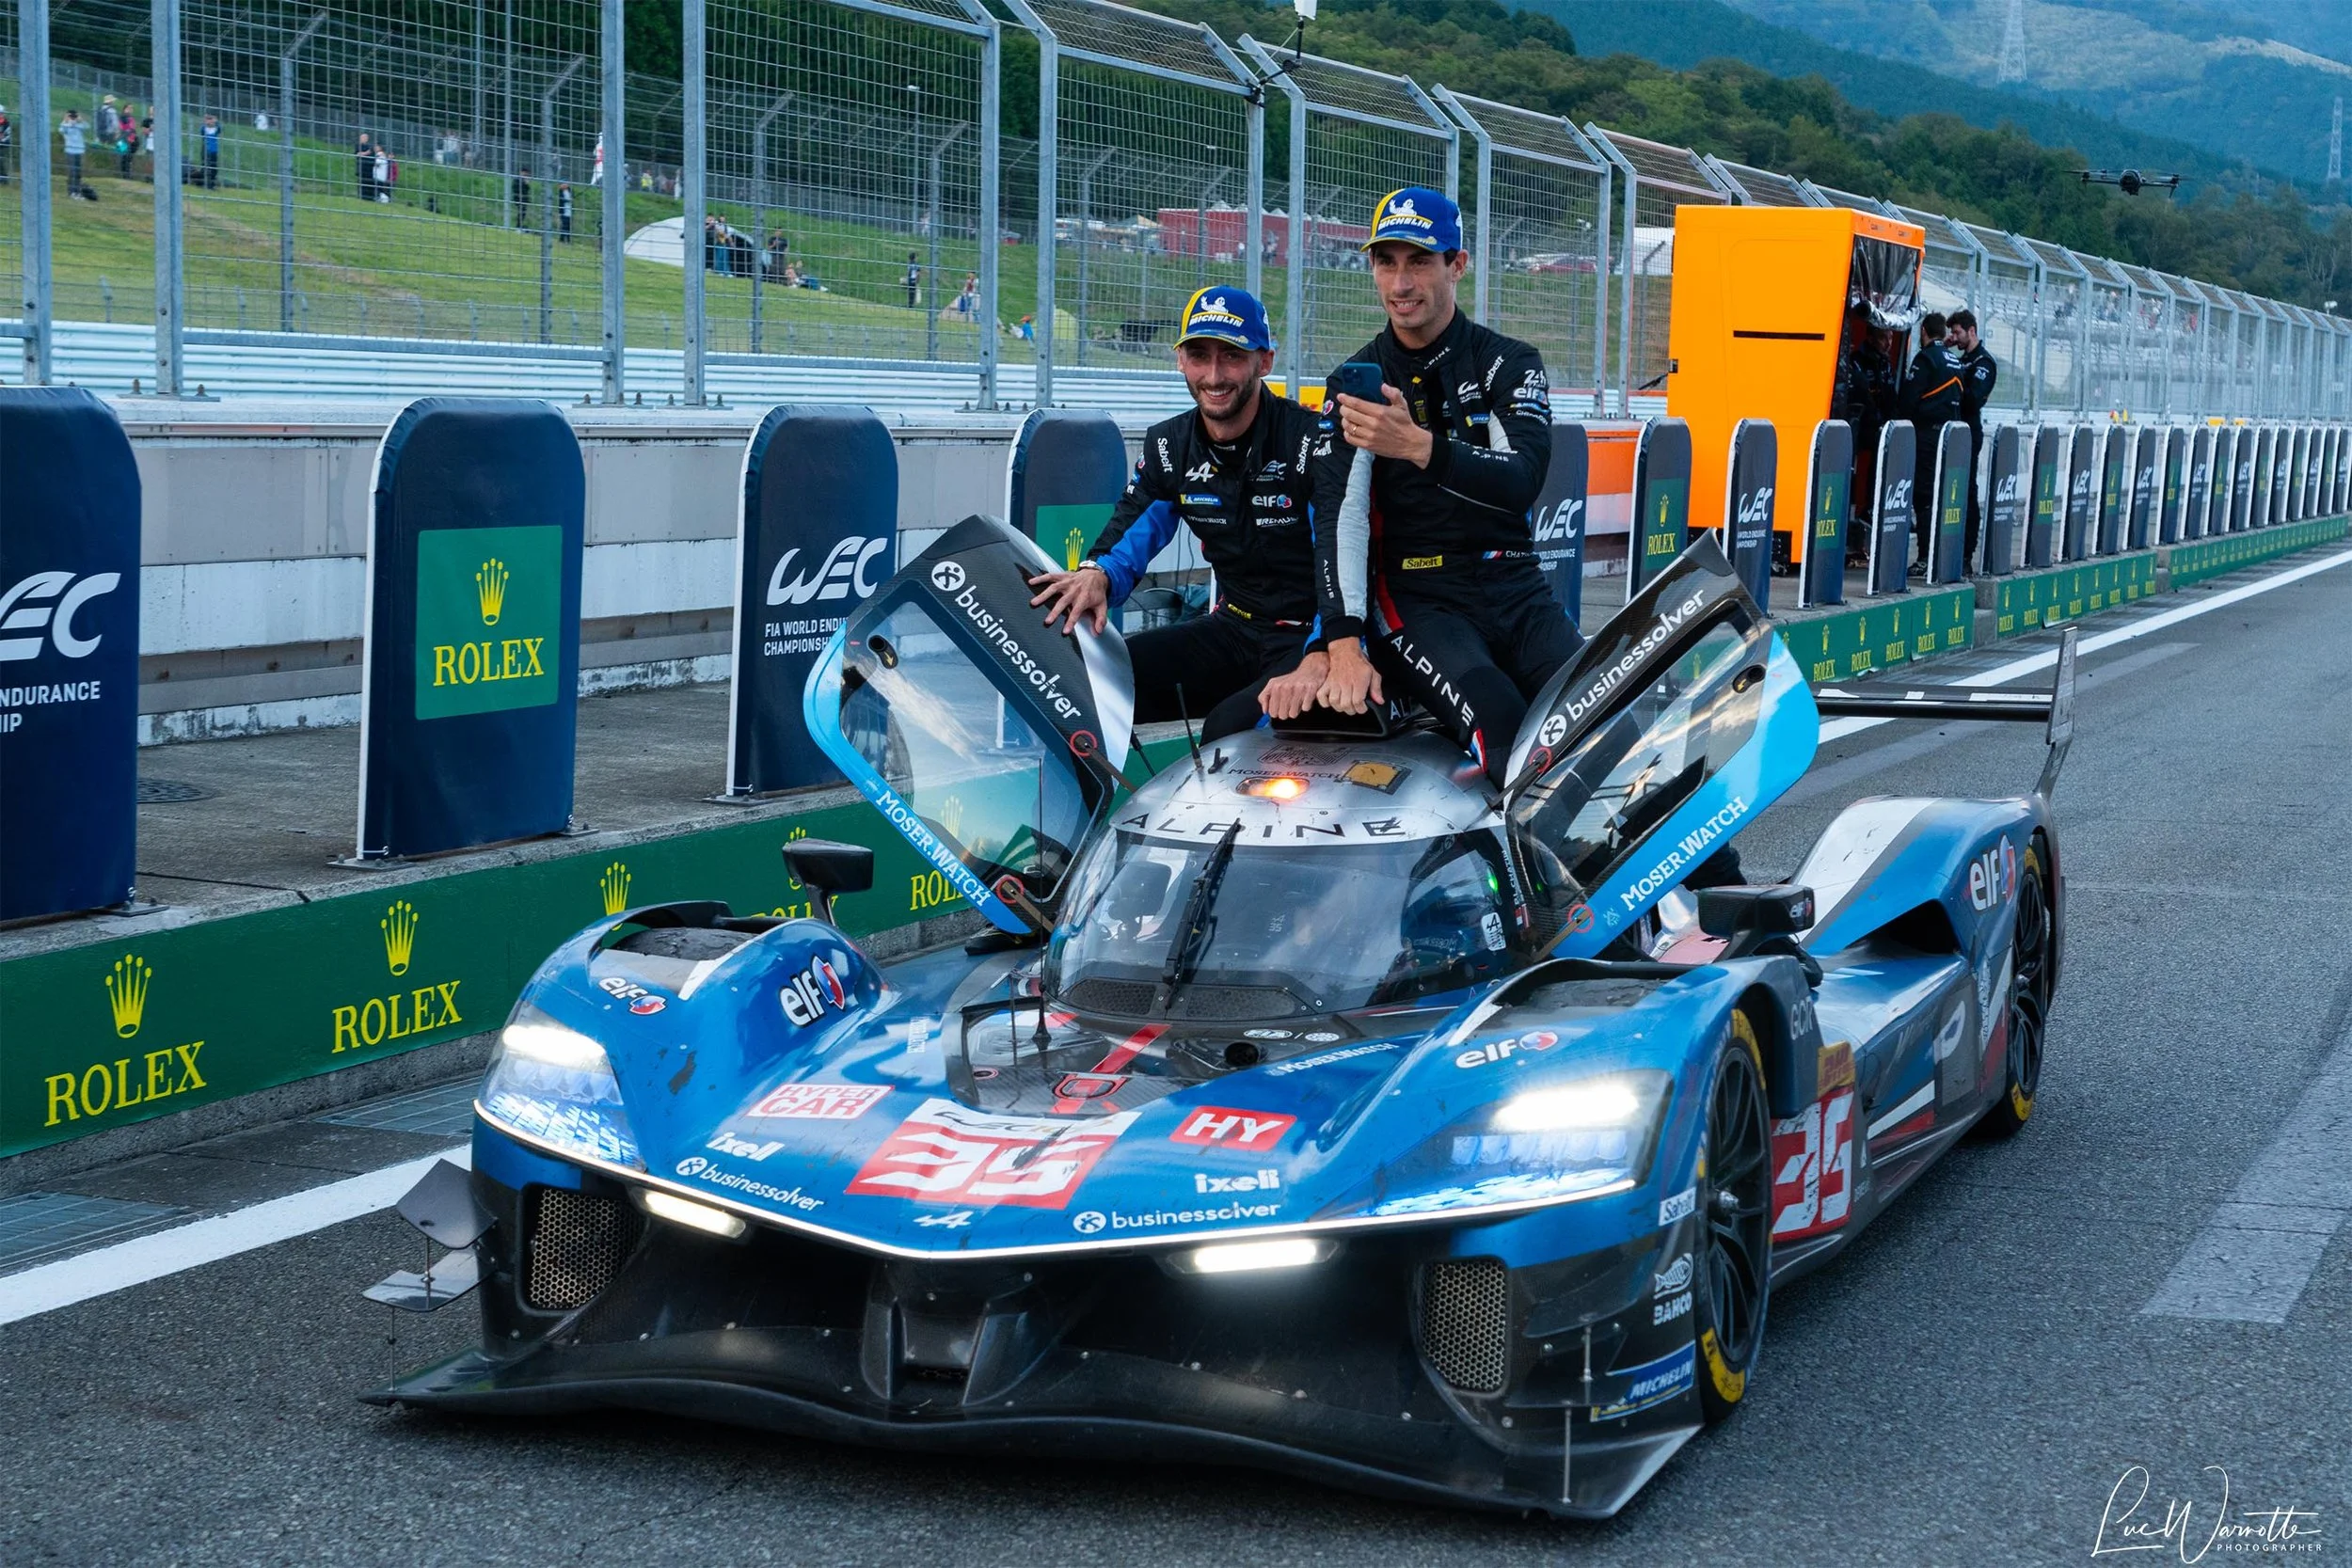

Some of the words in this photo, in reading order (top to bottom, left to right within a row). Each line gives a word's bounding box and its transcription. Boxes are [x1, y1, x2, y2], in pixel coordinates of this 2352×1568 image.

[1378, 217, 1432, 230] MICHELIN
[1188, 314, 1243, 327] MICHELIN
[1424, 346, 1451, 370] LPINE
[1158, 437, 1173, 472] Sabelt
[1296, 435, 1311, 474] Sabelt
[1252, 496, 1276, 507] elf
[1738, 487, 1772, 523] WEC
[1884, 479, 1912, 511] WEC
[1534, 499, 1583, 542] WEC
[1647, 532, 1676, 555] ROLEX
[767, 536, 888, 605] WEC
[1406, 557, 1438, 568] Sabelt
[765, 622, 781, 638] FIA
[783, 620, 818, 636] WORLD
[1917, 632, 1935, 653] ROLEX
[1948, 626, 1964, 645] ROLEX
[764, 636, 833, 656] CHAMPIONSH
[956, 584, 1082, 721] businessolver
[1565, 589, 1704, 722] businessolver
[1851, 650, 1871, 672] ROLEX
[1886, 641, 1904, 661] ROLEX
[432, 637, 545, 687] ROLEX
[1813, 659, 1836, 682] ROLEX
[0, 680, 101, 707] NDURANCE
[1391, 634, 1474, 726] ALPINE
[1120, 812, 1407, 838] ALPINE
[876, 790, 992, 908] MOSER.WATCH
[1619, 795, 1750, 911] MOSER.WATCH
[910, 869, 964, 911] ROL
[1970, 848, 1999, 911] elf
[598, 976, 649, 1001] elf
[779, 970, 826, 1026] elf
[331, 980, 462, 1053] ROLEX
[1455, 1038, 1518, 1069] elf
[44, 1041, 206, 1127] ROLEX
[778, 1086, 881, 1099] HYPER
[760, 1097, 866, 1116] CAR
[1184, 1112, 1283, 1143] HY
[707, 1132, 785, 1162] ixell
[1772, 1091, 1853, 1234] 35
[859, 1131, 1104, 1196] 35
[700, 1163, 825, 1212] businessolver
[1195, 1168, 1280, 1194] ixell
[1653, 1291, 1692, 1325] BAHCO
[1630, 1357, 1693, 1400] MICHELIN
